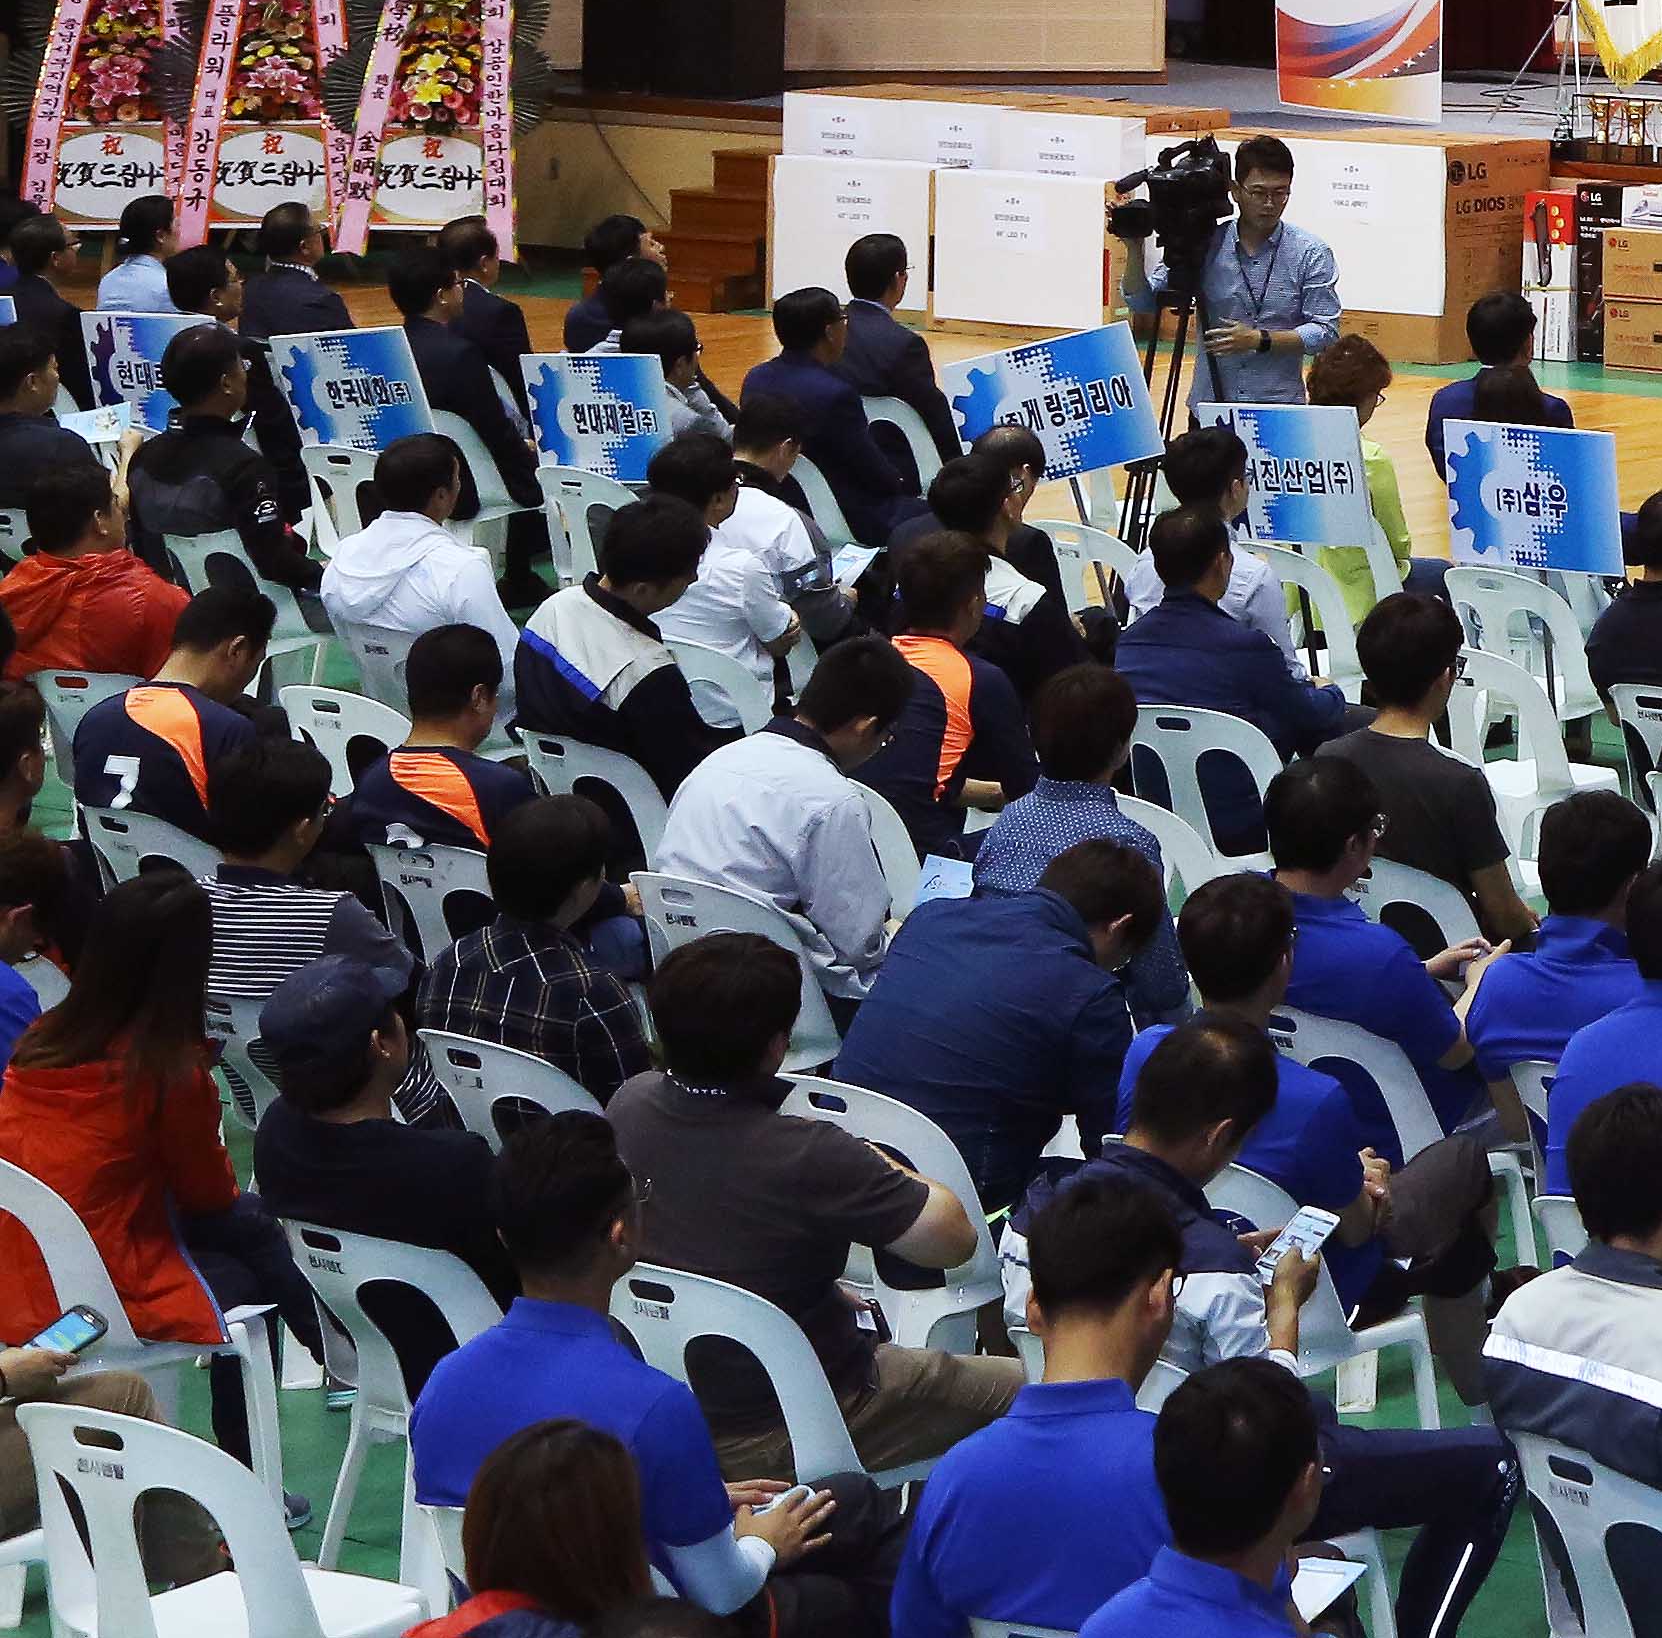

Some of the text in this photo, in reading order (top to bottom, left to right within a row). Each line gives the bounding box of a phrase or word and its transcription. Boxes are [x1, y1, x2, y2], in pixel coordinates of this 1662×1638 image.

[100, 135, 125, 156] 祝
[260, 133, 285, 155] 祝
[422, 137, 444, 159] 祝
[1468, 162, 1487, 180] LG
[1456, 200, 1471, 215] LG
[1473, 197, 1506, 213] DIOS
[1590, 192, 1602, 202] LG
[1617, 238, 1629, 249] LG
[1617, 308, 1630, 319] LG
[325, 376, 413, 410] 한국내화(주)
[572, 402, 659, 436] 현대제철(주)
[1496, 481, 1568, 516] (주)삼우
[104, 755, 140, 810] 7
